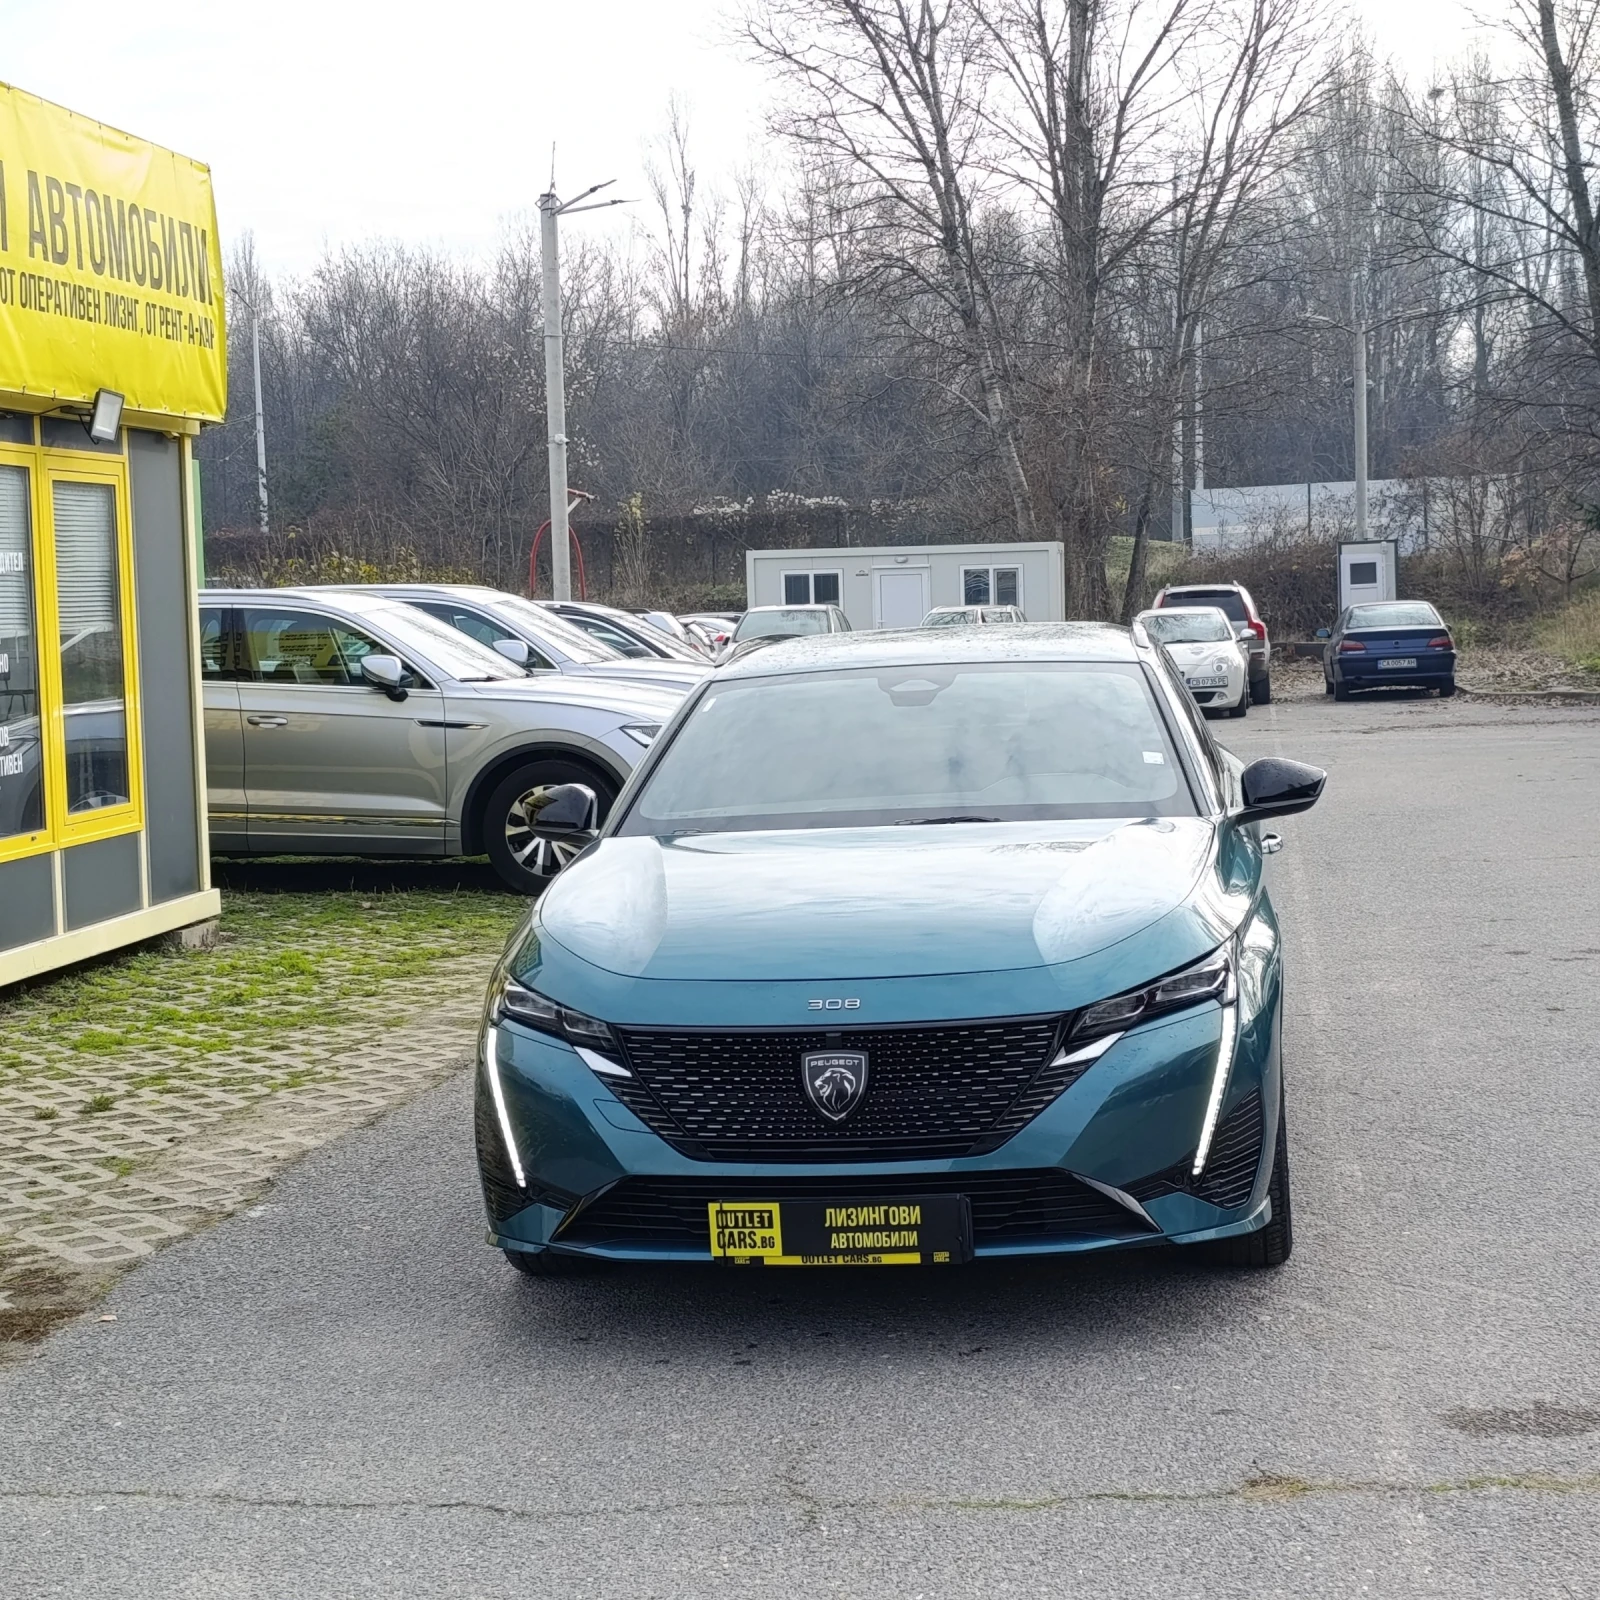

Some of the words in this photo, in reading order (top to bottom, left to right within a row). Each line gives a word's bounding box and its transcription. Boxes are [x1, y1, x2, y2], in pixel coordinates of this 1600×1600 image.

[27, 169, 213, 306] АВТОМОБИЛИ
[0, 267, 15, 306] ОТ
[19, 271, 101, 325] ОПЕРАТИВЕН
[145, 301, 158, 337] ОТ
[159, 306, 215, 350] РЕНТ-А-КАР
[807, 998, 861, 1010] 308
[810, 1059, 860, 1067] PEUGEOT
[717, 1212, 770, 1227] OUTLET
[824, 1205, 921, 1228] ЛИЗИНГОВИ
[716, 1230, 775, 1249] CARS.BG
[830, 1230, 919, 1249] АВТОМОБИЛИ
[801, 1254, 839, 1264] OUTLET
[842, 1253, 883, 1264] CARS.BG
